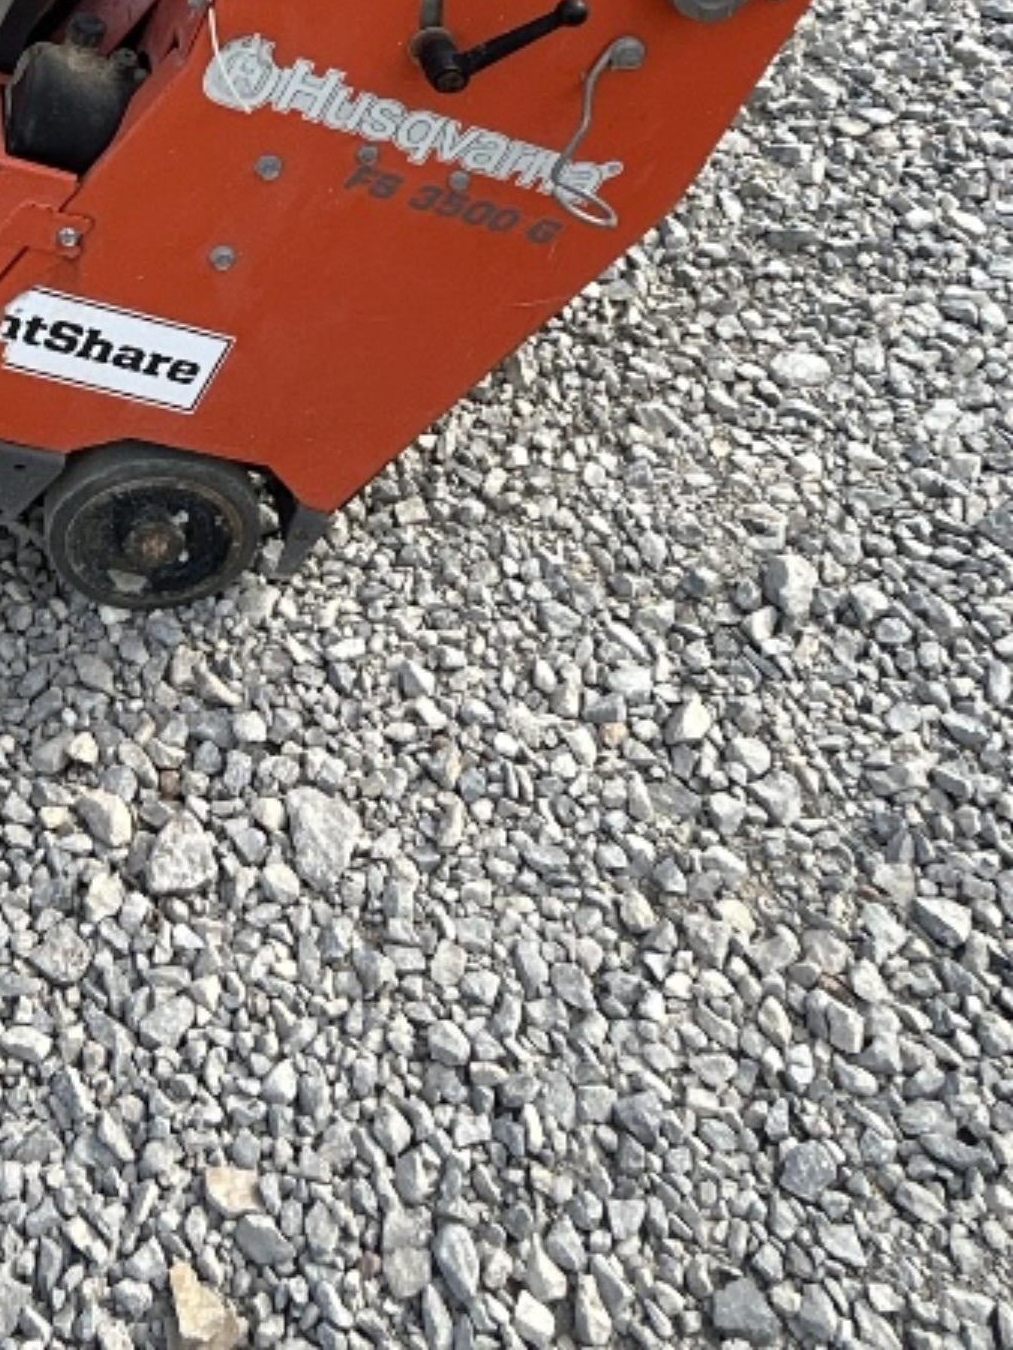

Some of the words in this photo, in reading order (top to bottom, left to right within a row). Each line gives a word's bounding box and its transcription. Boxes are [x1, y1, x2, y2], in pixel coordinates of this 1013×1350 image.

[272, 58, 602, 204] Husqvarna
[407, 183, 523, 233] 3500
[527, 217, 566, 245] G
